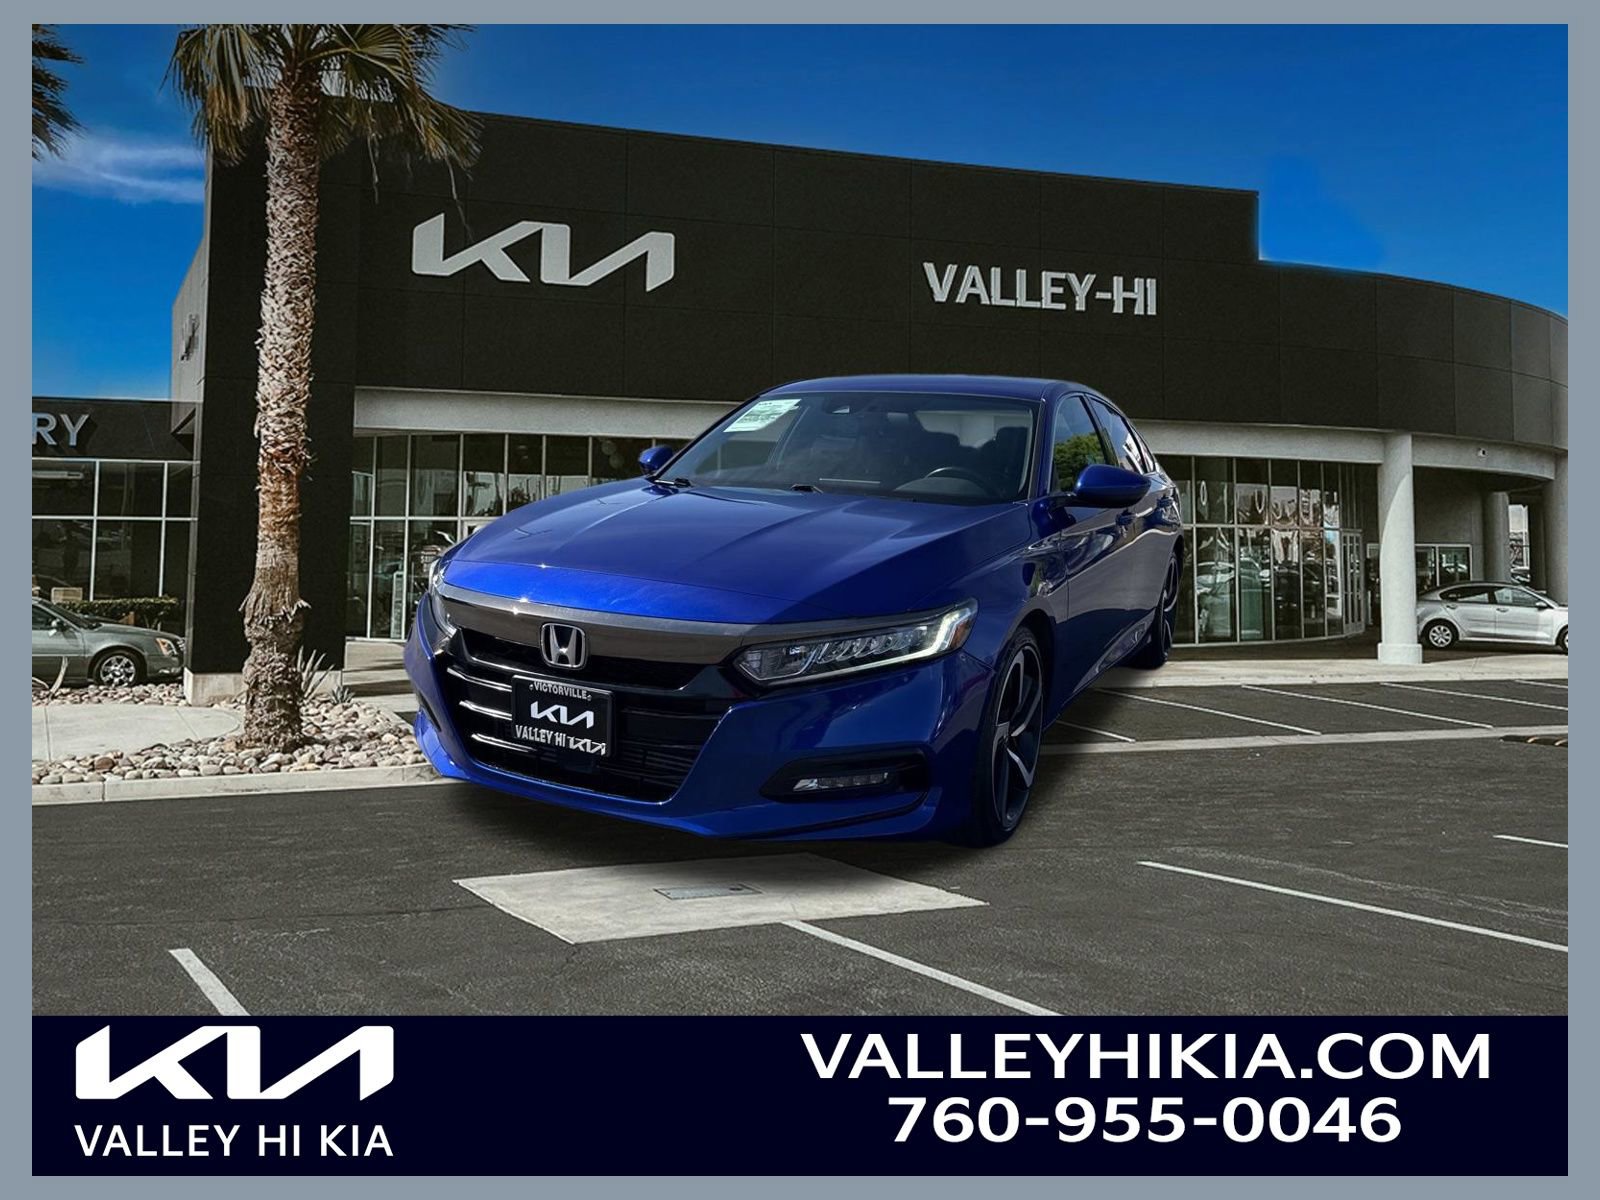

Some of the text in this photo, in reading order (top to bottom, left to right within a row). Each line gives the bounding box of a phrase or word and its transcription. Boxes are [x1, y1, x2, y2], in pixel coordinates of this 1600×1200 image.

[411, 212, 675, 292] KIA
[922, 262, 1158, 316] VALLEY-HI
[534, 682, 587, 699] VICTORVILLE
[531, 701, 594, 728] KIA
[516, 725, 606, 755] VALLEY HI KIA
